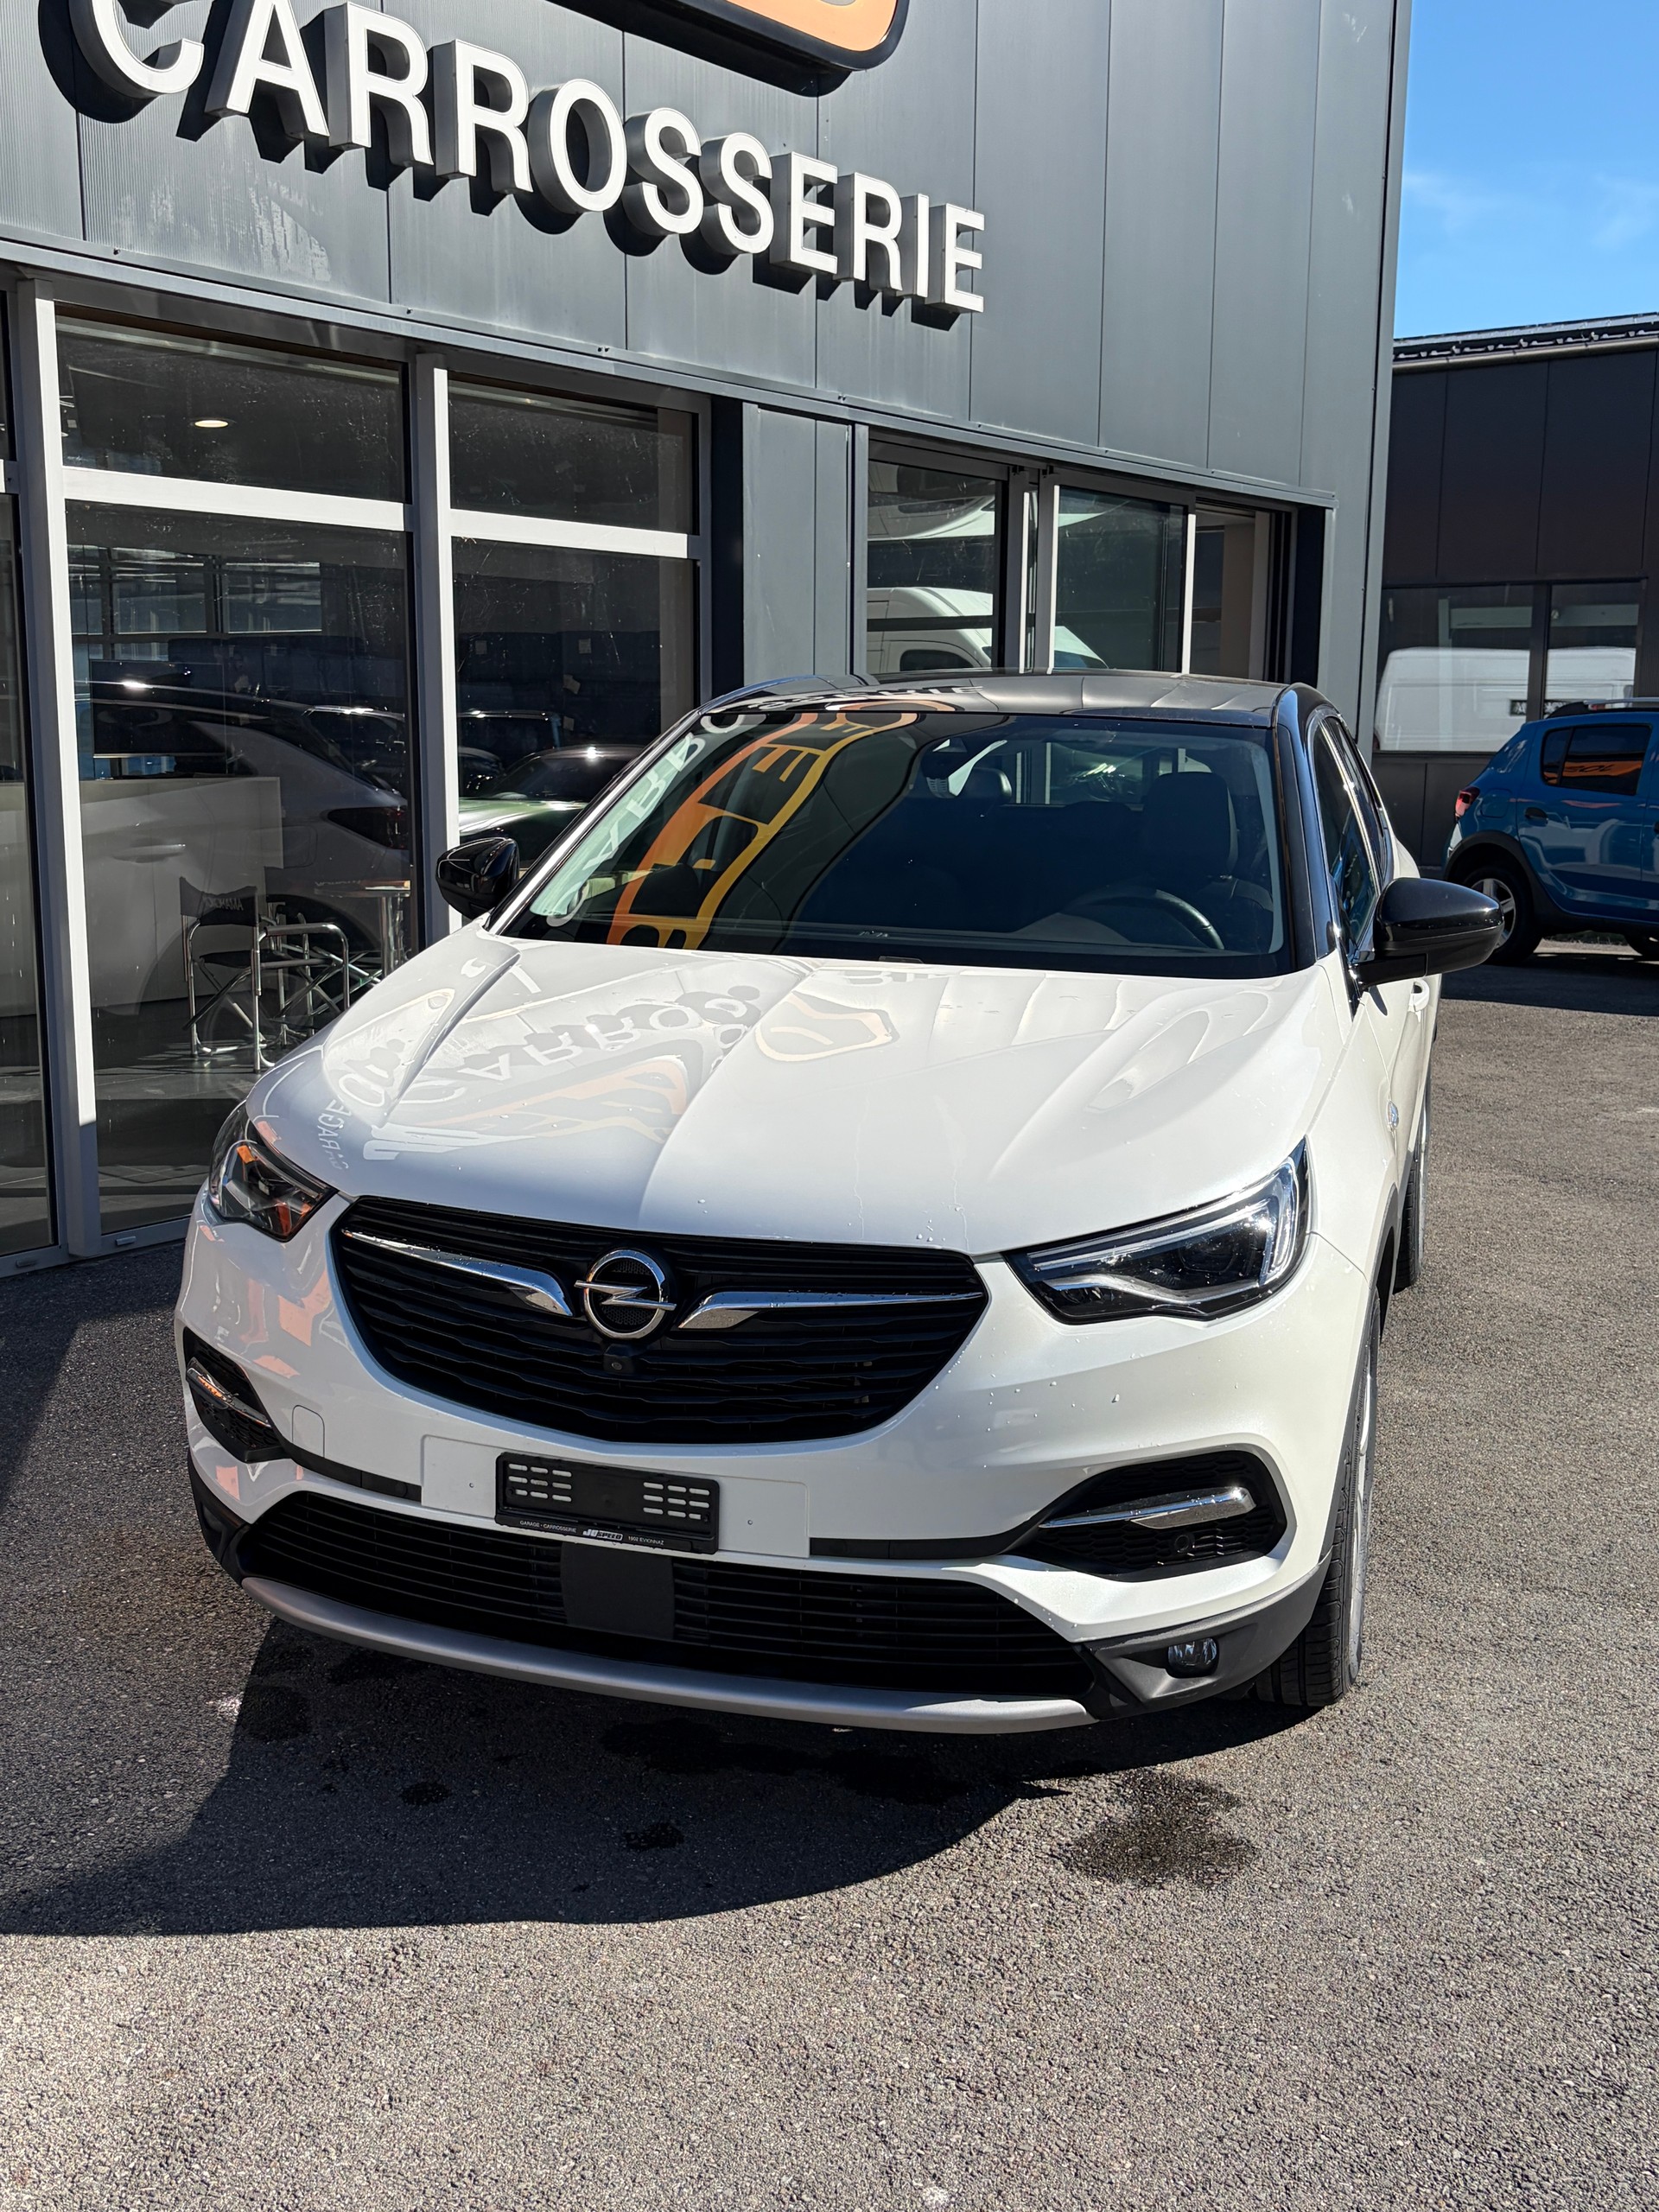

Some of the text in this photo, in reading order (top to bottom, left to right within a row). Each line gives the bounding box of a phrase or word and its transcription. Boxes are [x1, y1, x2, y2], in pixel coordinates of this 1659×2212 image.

[74, 0, 985, 314] CARROSSERIE
[543, 1523, 577, 1533] CARROSSERIE
[598, 1530, 623, 1541] SPEED
